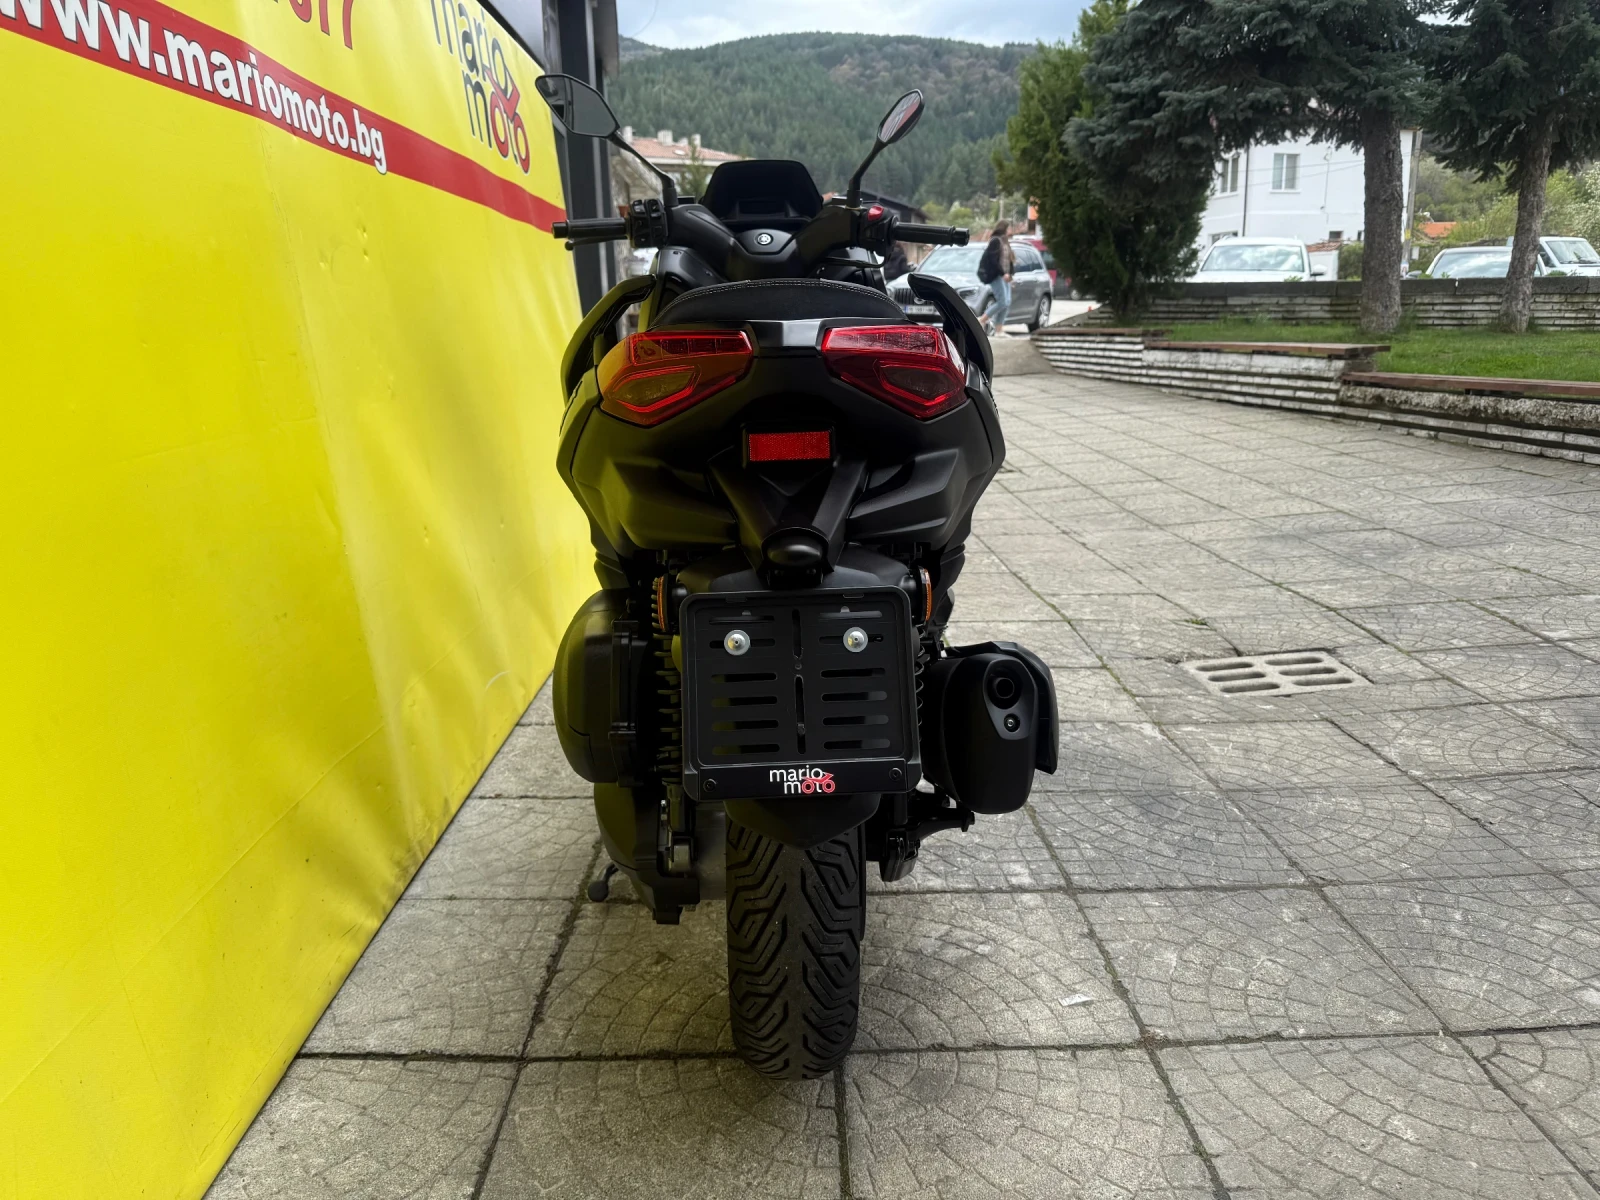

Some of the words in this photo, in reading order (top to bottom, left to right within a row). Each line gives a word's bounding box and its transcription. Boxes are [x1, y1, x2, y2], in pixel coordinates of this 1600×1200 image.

[430, 0, 509, 95] mario
[461, 70, 530, 174] moto
[769, 765, 823, 782] mario
[783, 780, 836, 795] moto
